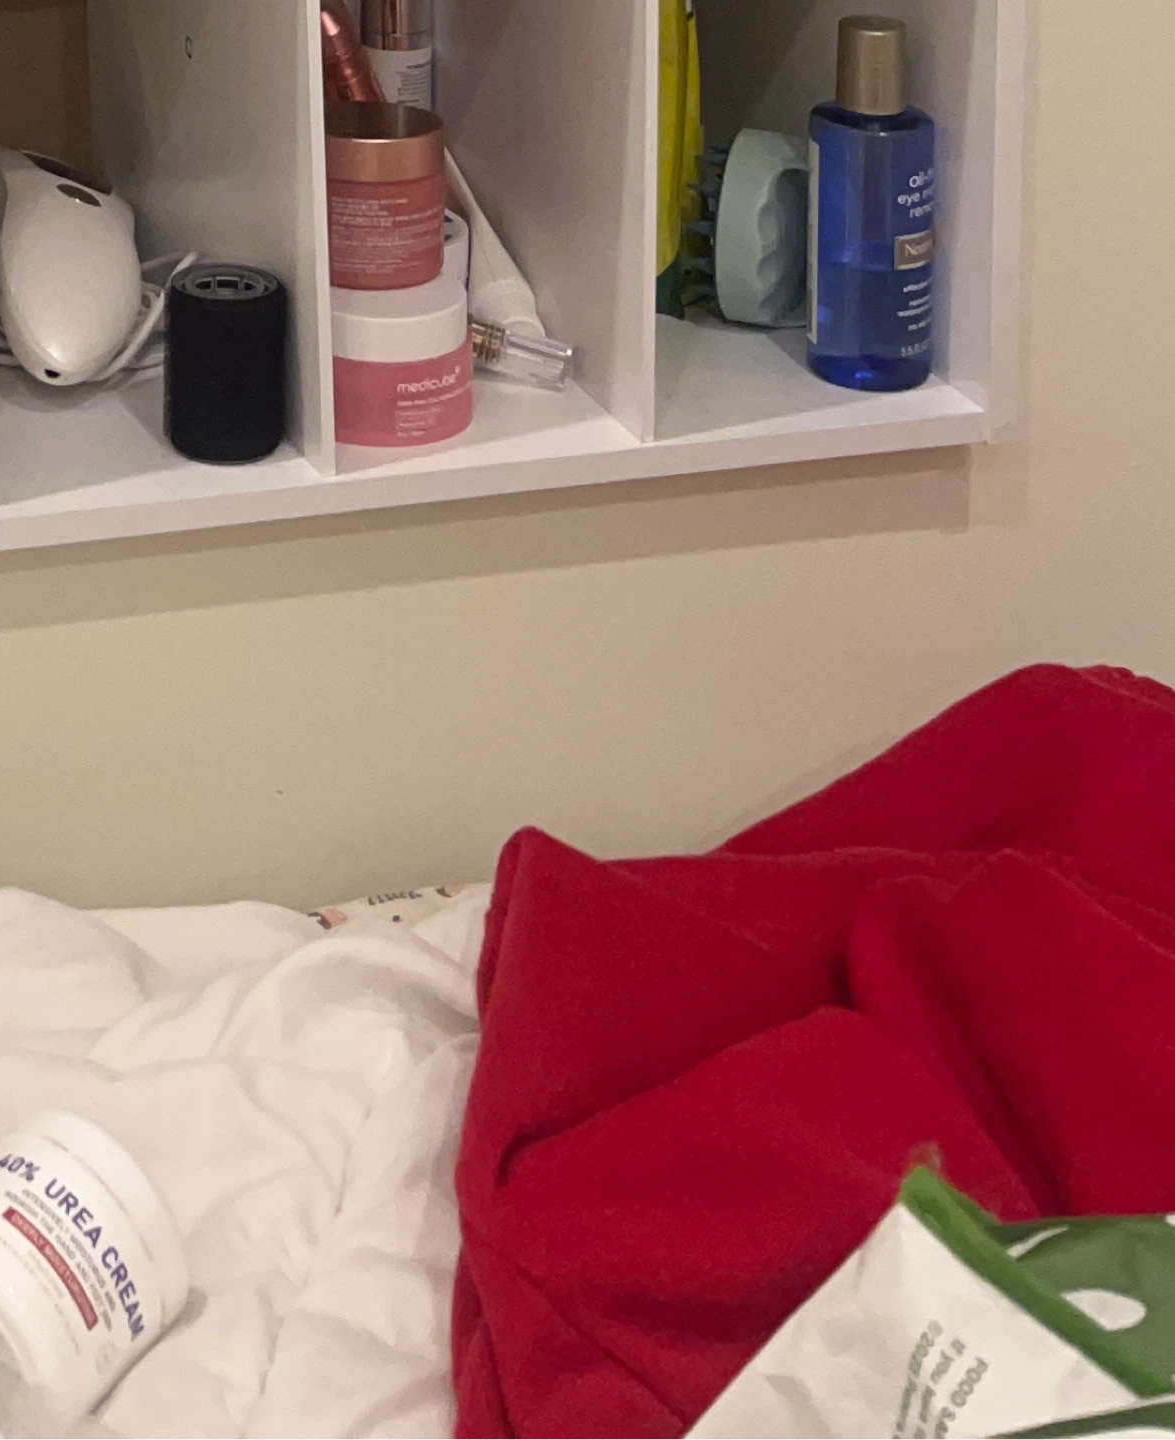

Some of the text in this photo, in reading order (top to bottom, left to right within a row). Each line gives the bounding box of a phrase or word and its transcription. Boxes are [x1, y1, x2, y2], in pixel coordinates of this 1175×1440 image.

[897, 192, 921, 207] eye
[396, 372, 458, 393] medicube
[44, 1177, 103, 1249] UREA
[101, 1245, 145, 1342] CREAM
